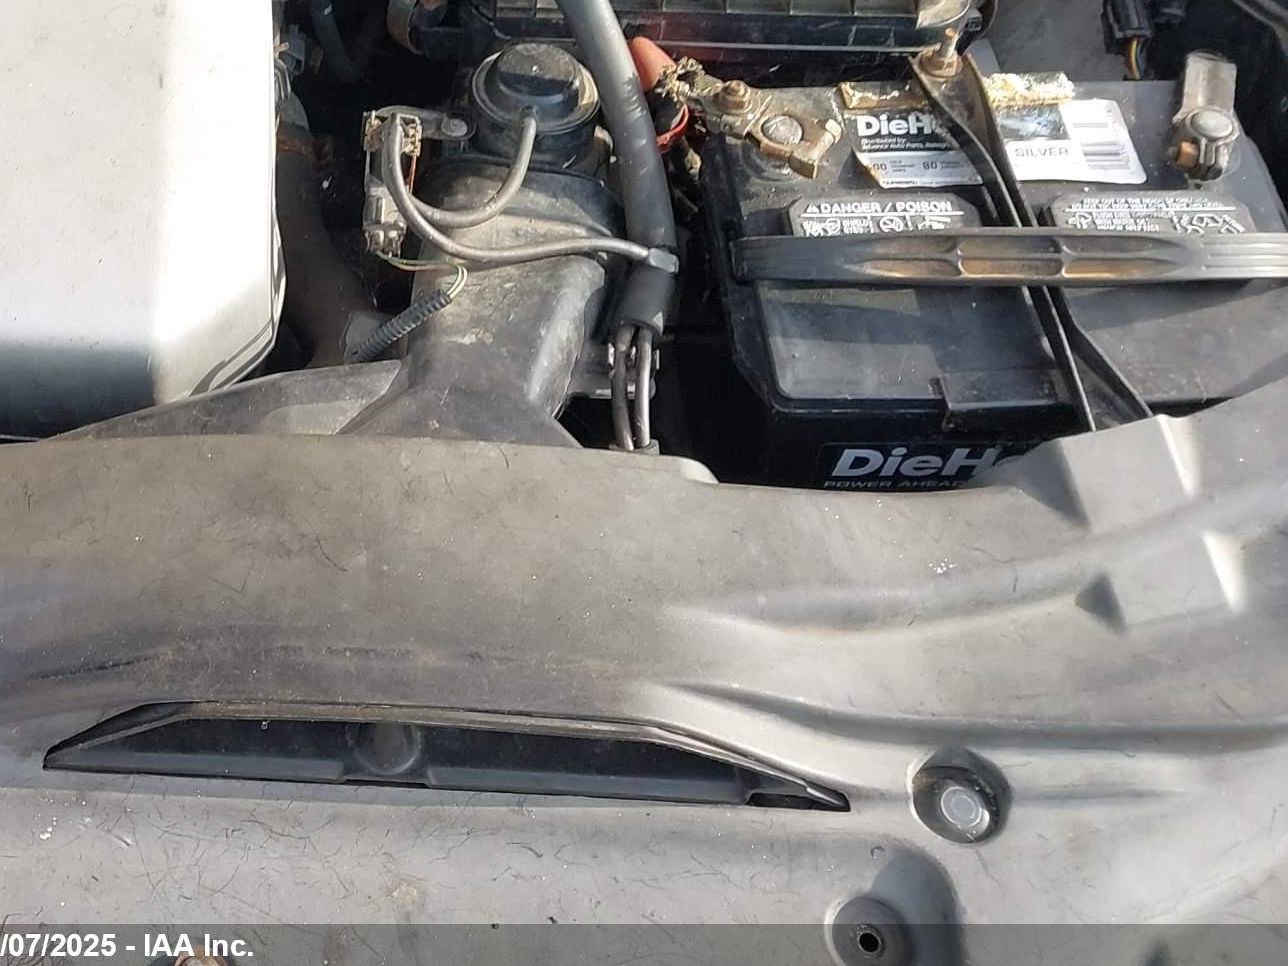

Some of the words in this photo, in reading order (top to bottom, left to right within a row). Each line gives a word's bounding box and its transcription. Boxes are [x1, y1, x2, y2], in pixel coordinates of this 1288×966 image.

[857, 113, 943, 136] DieH
[1015, 146, 1069, 158] SILVER
[820, 202, 882, 213] DANGER
[896, 201, 953, 212] POISON
[831, 447, 1001, 477] DieH
[824, 480, 892, 489] POWER
